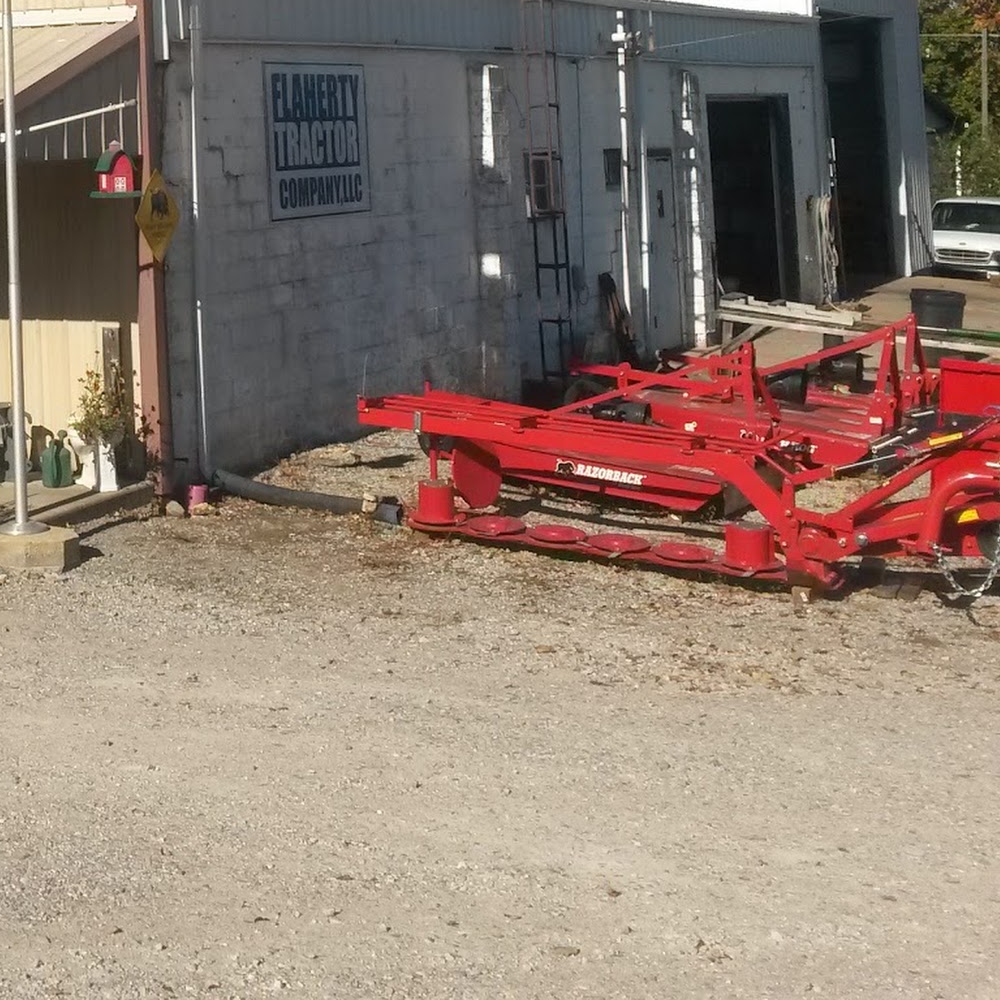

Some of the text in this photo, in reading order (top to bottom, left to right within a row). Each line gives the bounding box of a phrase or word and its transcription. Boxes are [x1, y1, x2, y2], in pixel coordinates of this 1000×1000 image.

[271, 73, 360, 120] FLAHERTY
[274, 119, 360, 168] TRACTOR
[575, 464, 643, 485] RAZORBACK
